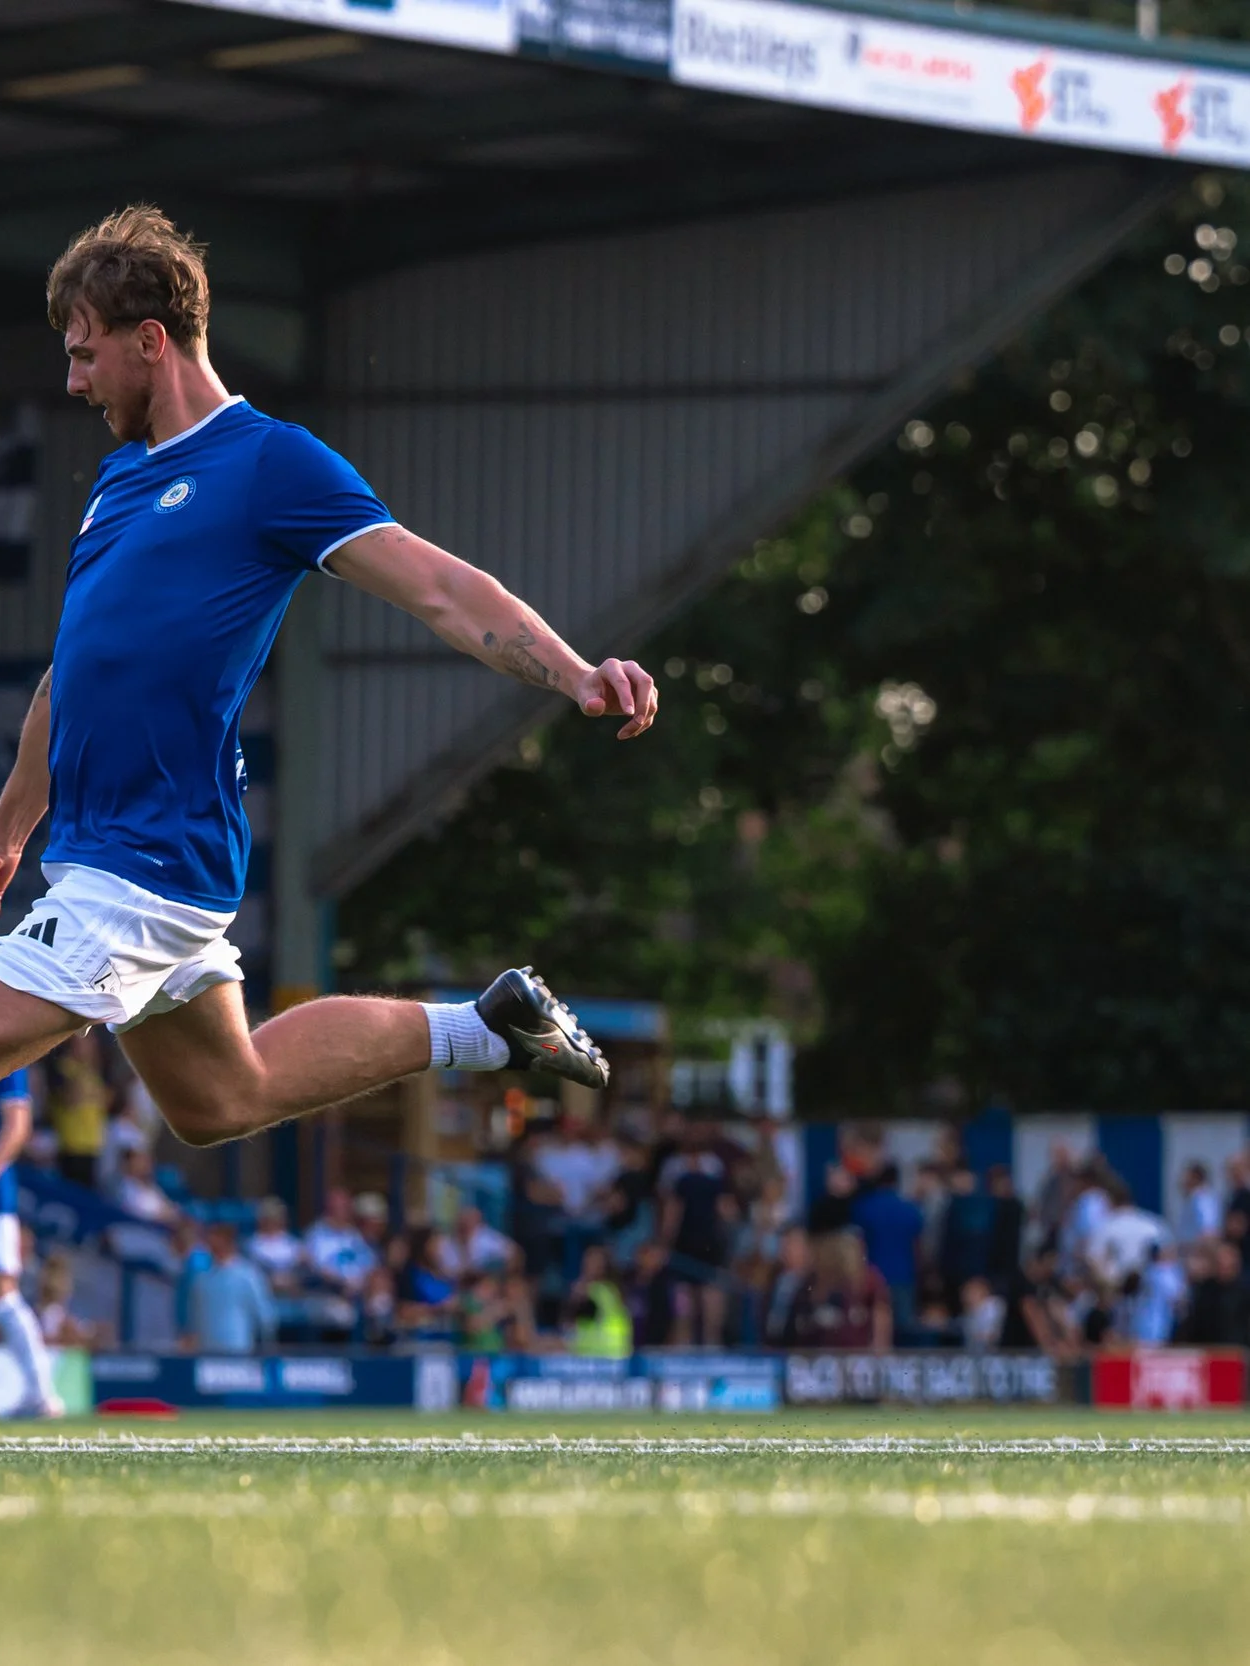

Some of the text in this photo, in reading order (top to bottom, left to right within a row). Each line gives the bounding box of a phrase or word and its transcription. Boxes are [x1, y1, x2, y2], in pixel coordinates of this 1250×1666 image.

[786, 1355, 842, 1399] BACK
[844, 1355, 875, 1399] TO
[877, 1355, 921, 1399] THE
[922, 1355, 978, 1399] BACK
[980, 1355, 1010, 1399] TO
[1012, 1355, 1057, 1399] THE
